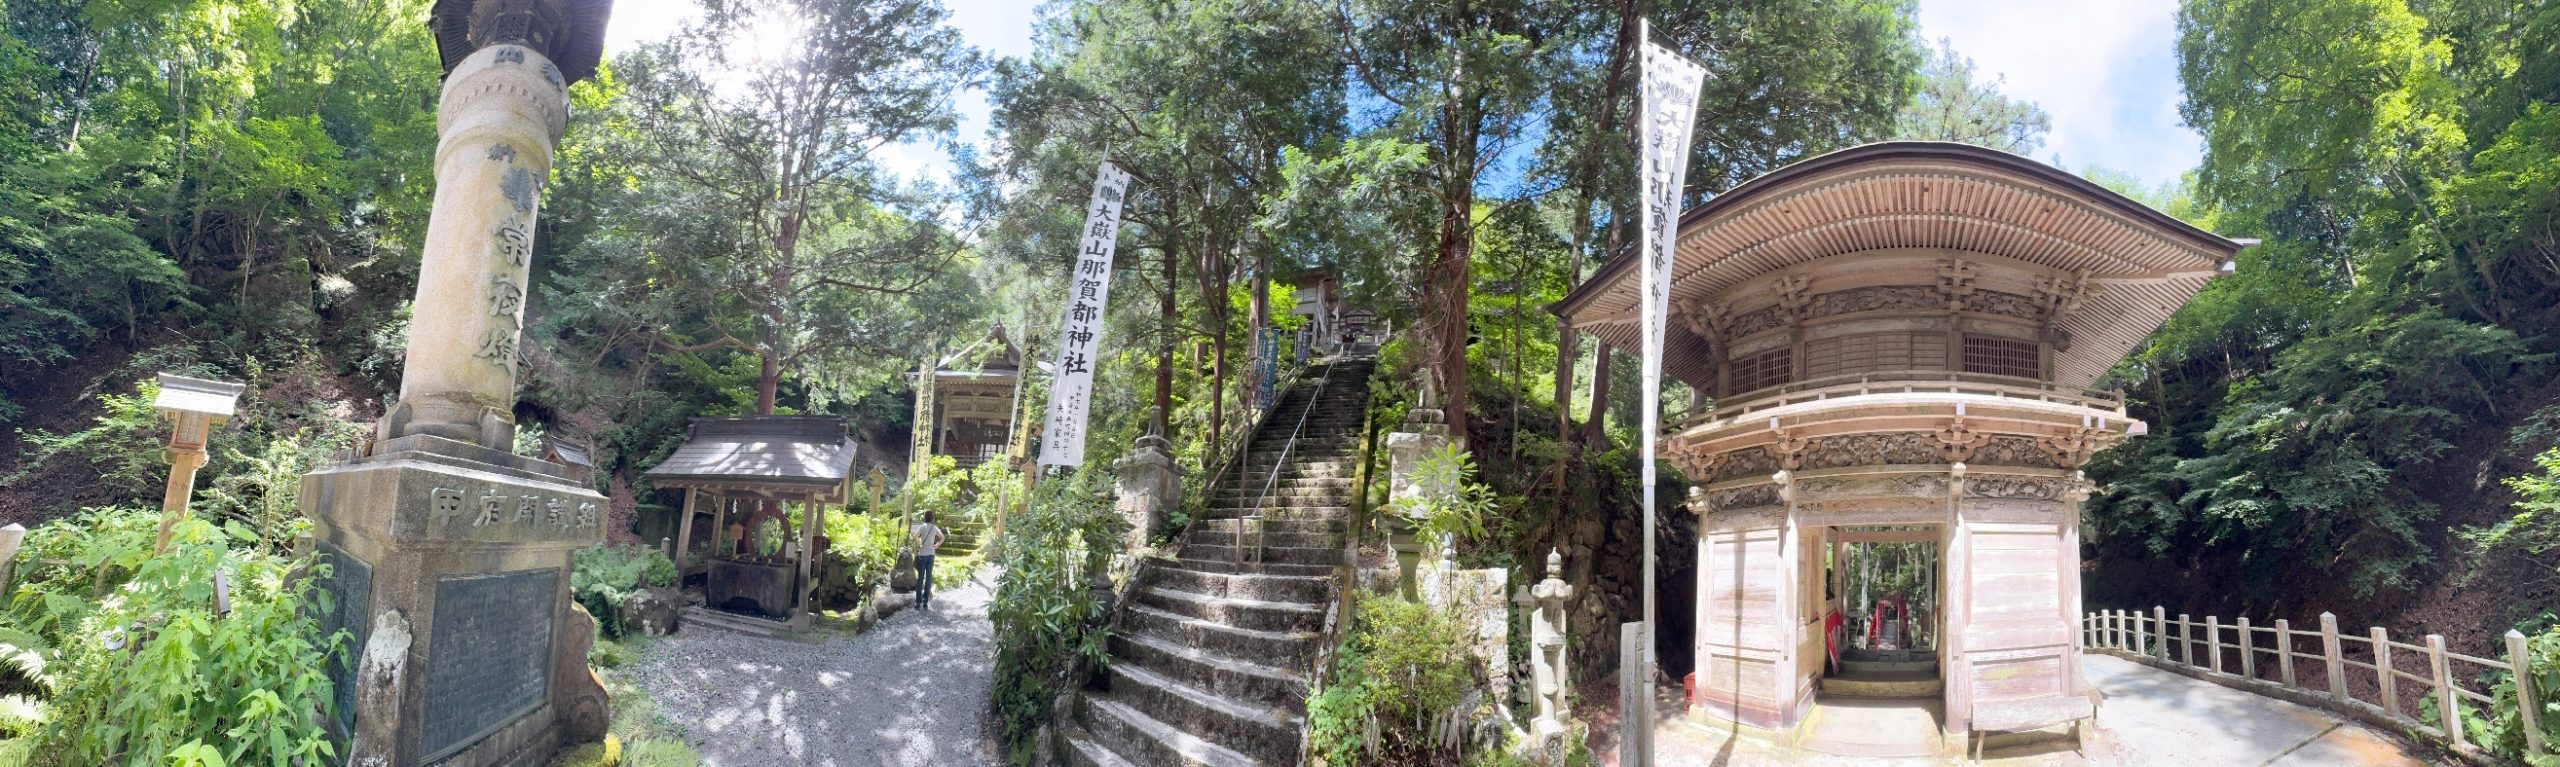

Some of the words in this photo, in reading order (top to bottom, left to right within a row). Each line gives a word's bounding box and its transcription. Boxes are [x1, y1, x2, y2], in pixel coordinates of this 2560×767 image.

[1062, 203, 1116, 376] 大嶽山那賀都神社
